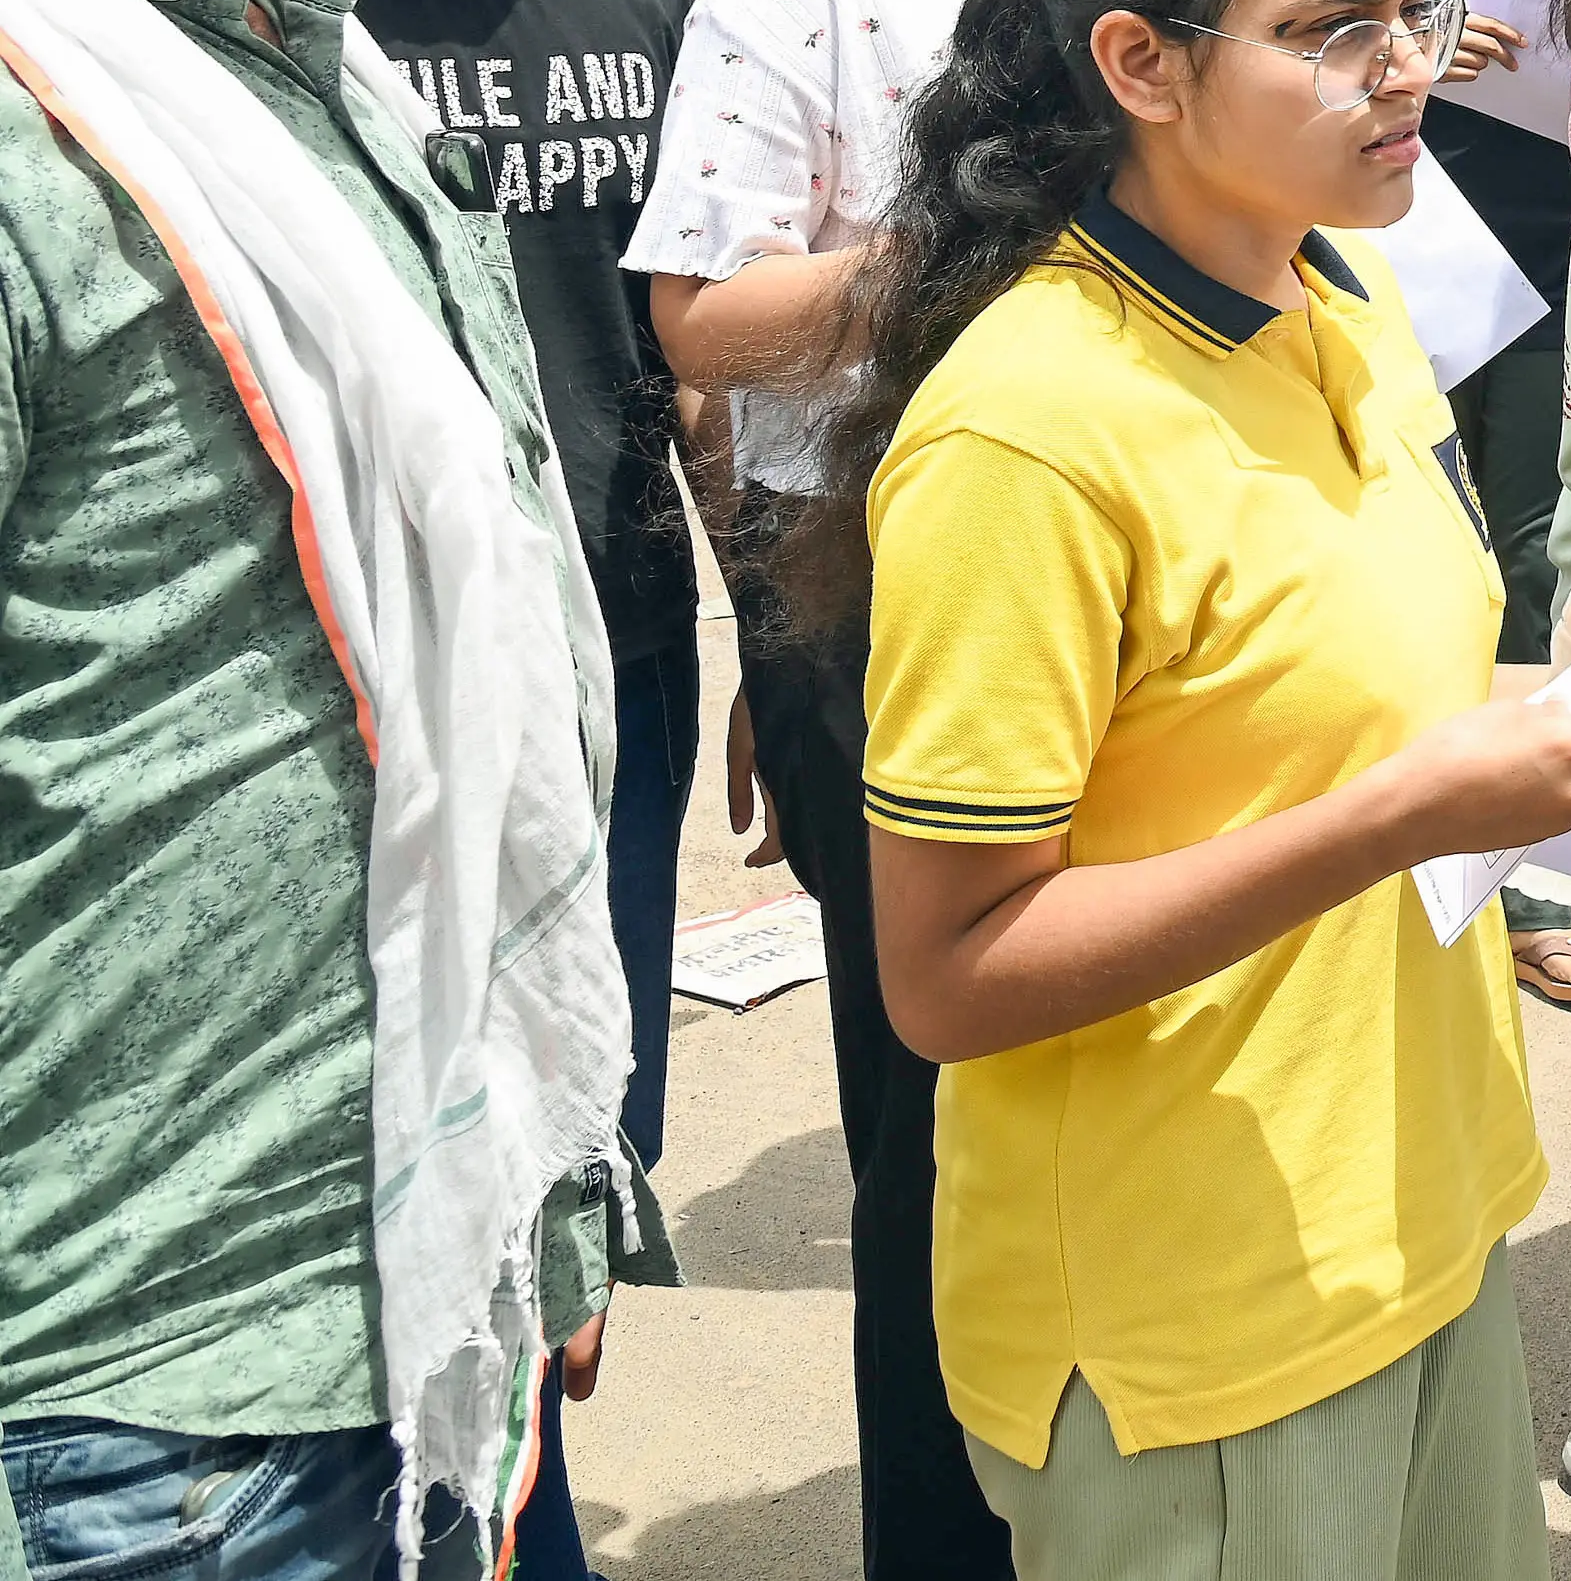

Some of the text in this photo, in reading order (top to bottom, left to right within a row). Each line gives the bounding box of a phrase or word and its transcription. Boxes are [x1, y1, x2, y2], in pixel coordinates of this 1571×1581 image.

[390, 53, 655, 128] ILE AND
[496, 133, 649, 215] APPY
